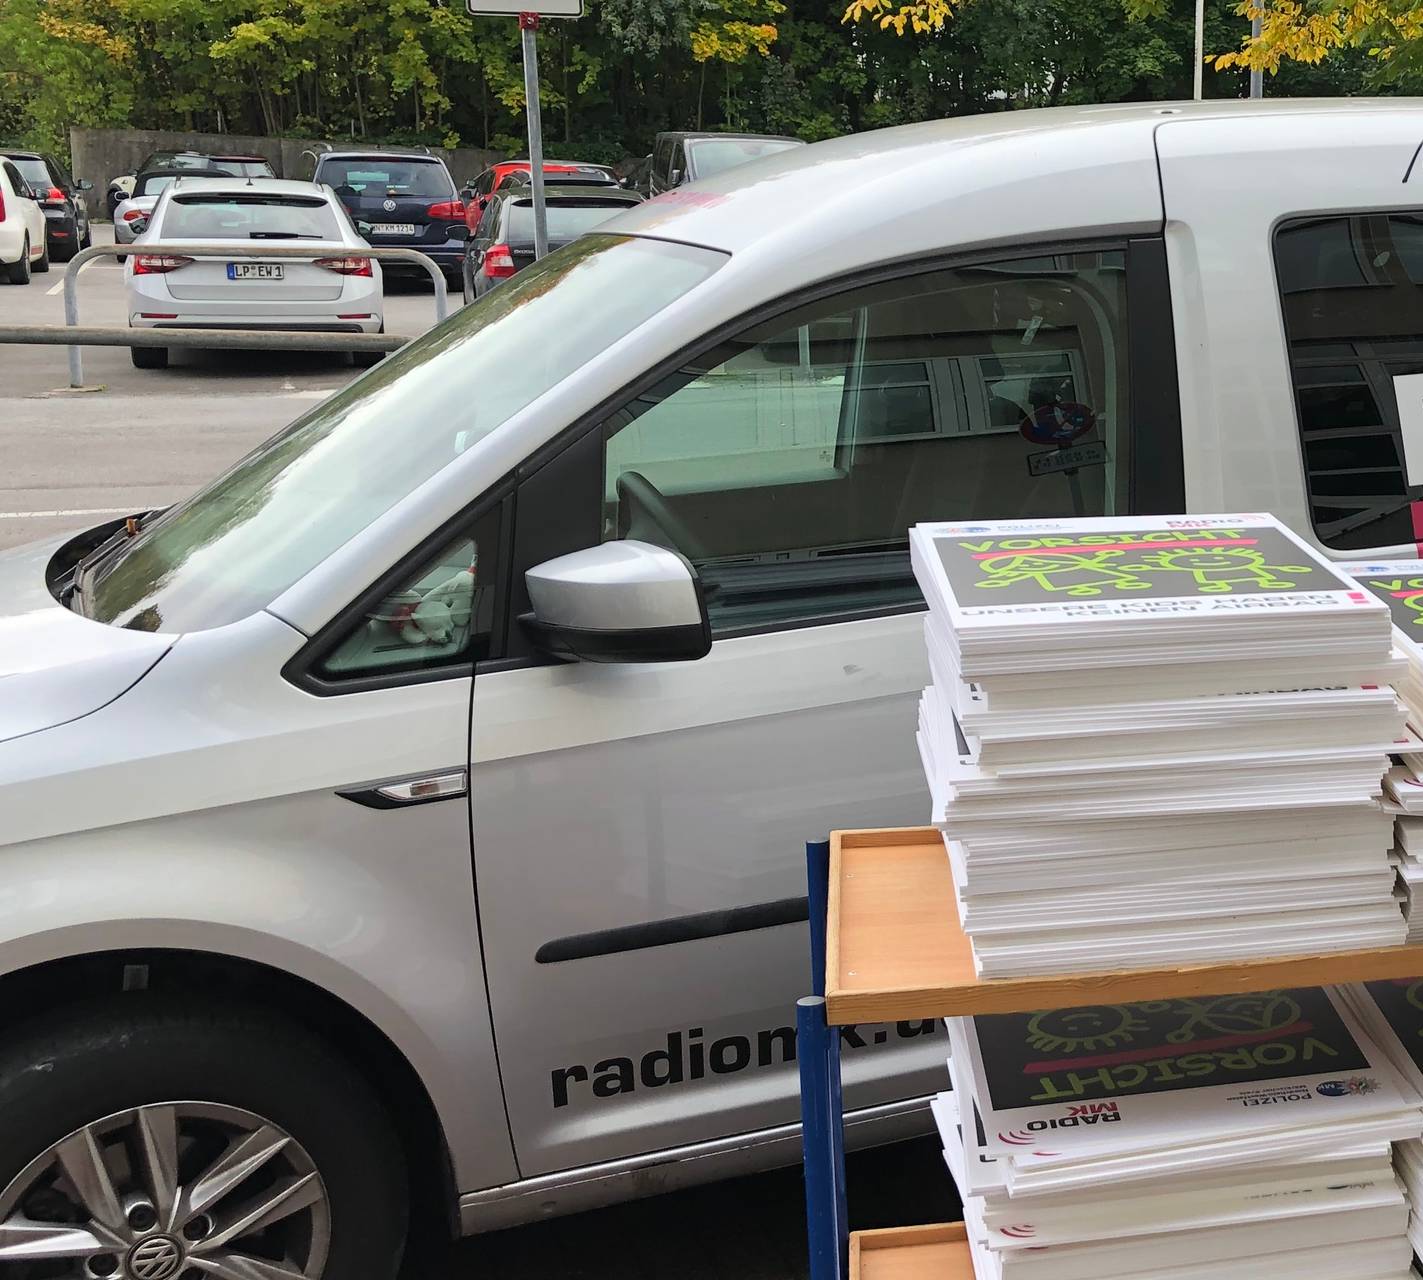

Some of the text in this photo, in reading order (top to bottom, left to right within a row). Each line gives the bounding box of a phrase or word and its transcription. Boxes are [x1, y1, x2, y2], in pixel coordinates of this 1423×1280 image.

[235, 266, 282, 277] LP EW 1
[957, 529, 1247, 553] VORSICHT
[960, 594, 1334, 616] UNSERE KIDS HABEN
[1066, 606, 1197, 617] KEINEN
[1211, 600, 1339, 610] AIRBAG
[1031, 1037, 1339, 1101] VORSICHT
[1067, 1102, 1118, 1116] MK
[1243, 1093, 1313, 1107] POLIZEI
[1027, 1112, 1121, 1131] RADIO
